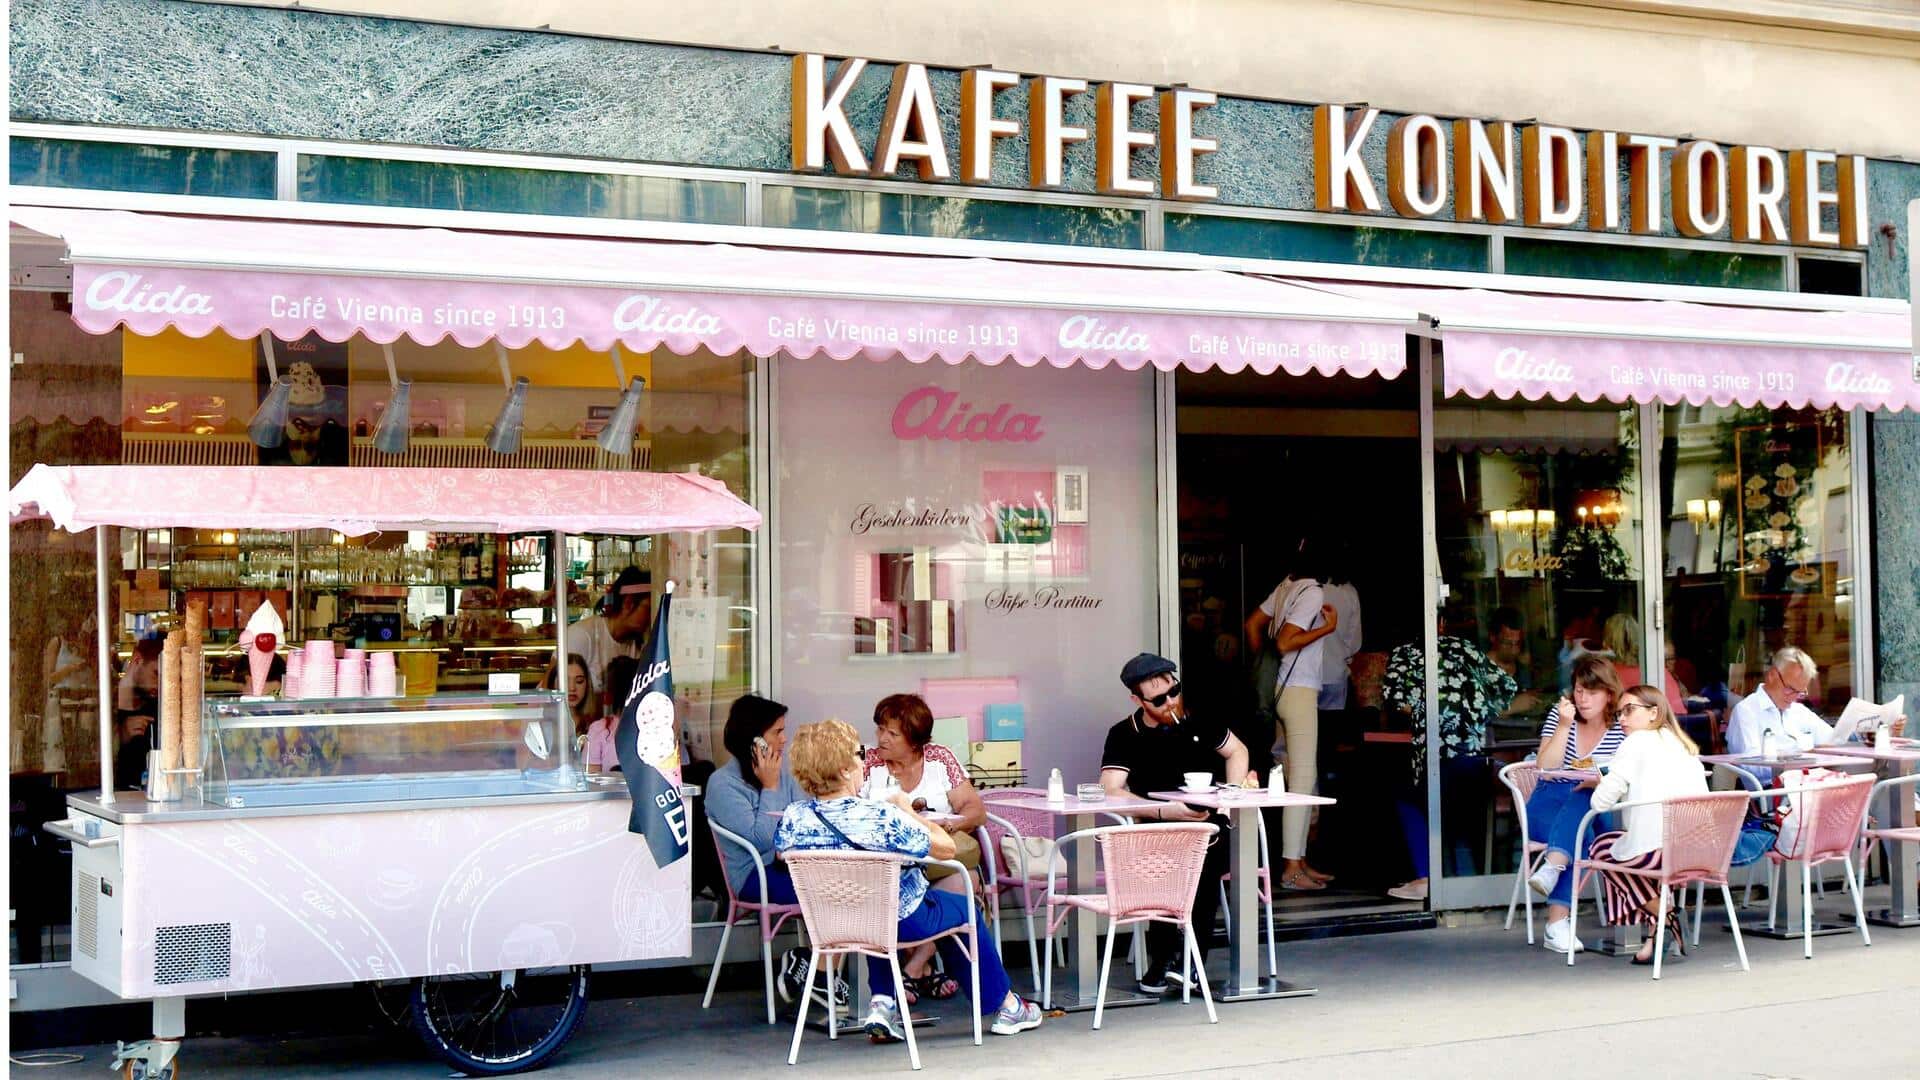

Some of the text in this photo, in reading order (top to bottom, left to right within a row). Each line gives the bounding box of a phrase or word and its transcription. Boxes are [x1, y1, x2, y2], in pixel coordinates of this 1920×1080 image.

[794, 52, 1868, 246] KAFFEE KONDITOREI
[270, 294, 566, 329] Café Vienna since 1913
[767, 315, 1019, 347] Café Vienna since 1913
[1188, 332, 1230, 355] Café
[1235, 335, 1300, 358] Vienna
[1307, 341, 1349, 360] since
[1610, 364, 1795, 392] Café Vienna since 1913
[850, 503, 972, 535] Geschenkideen
[1034, 585, 1103, 611] Partitur
